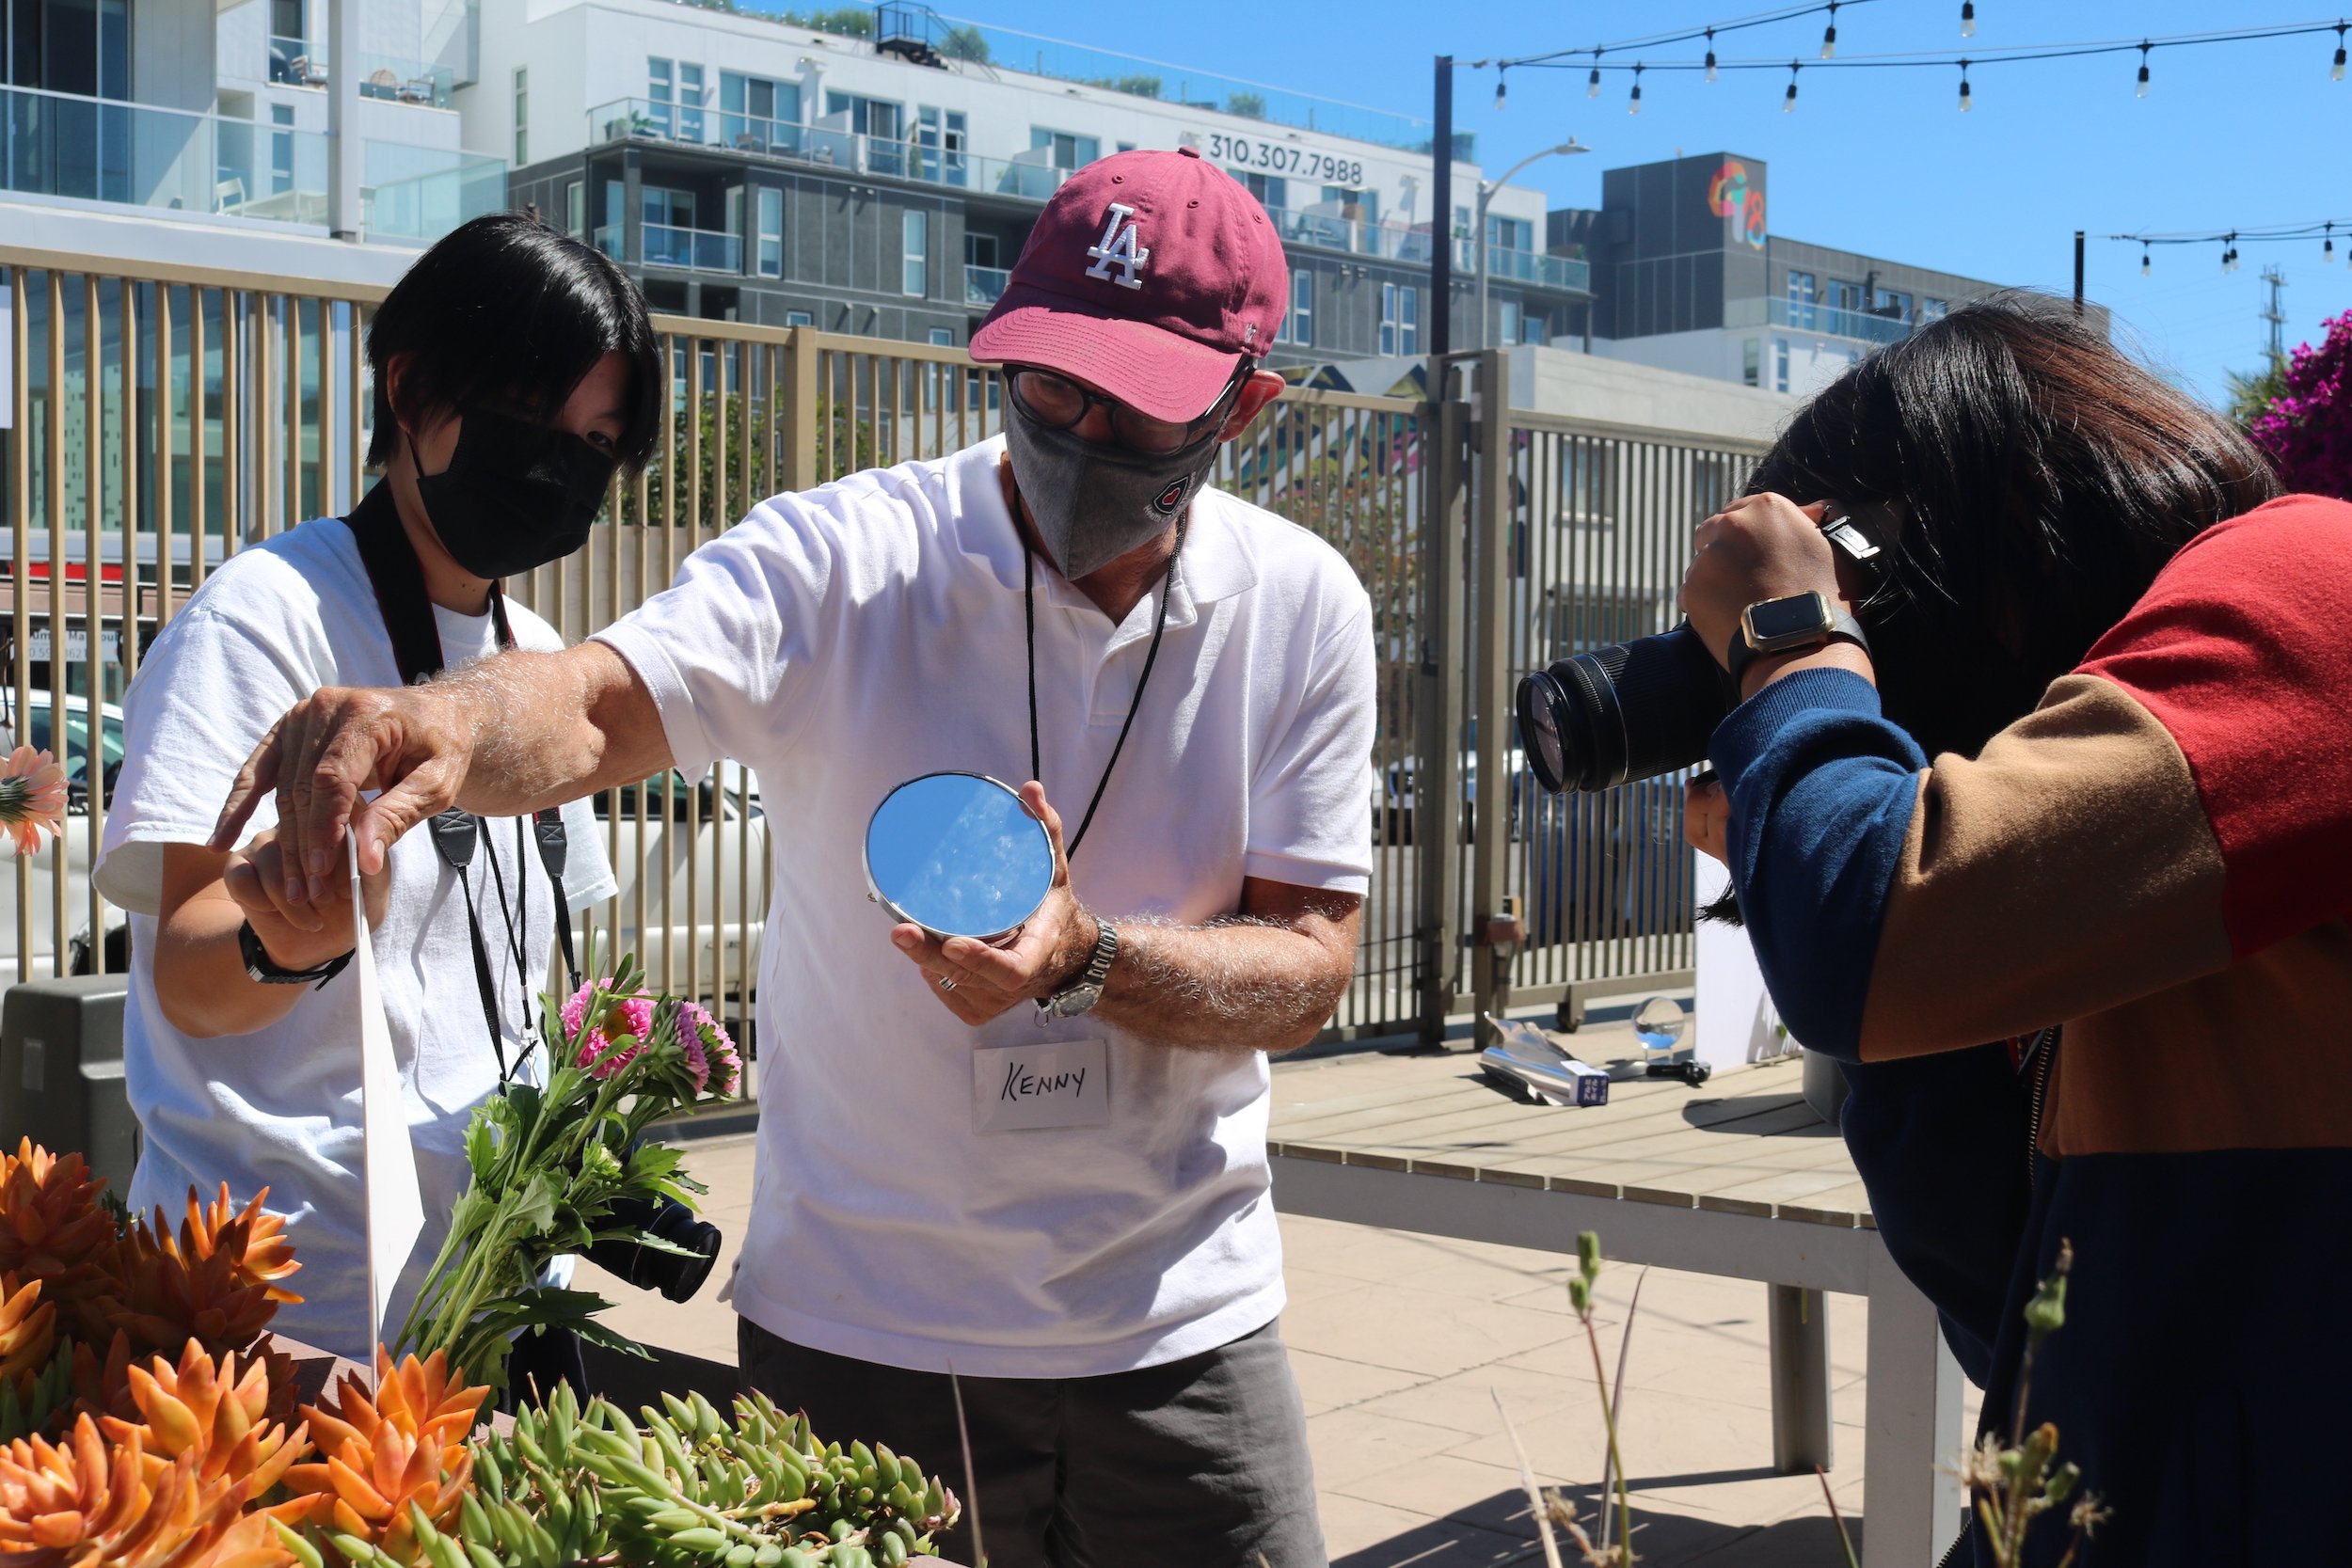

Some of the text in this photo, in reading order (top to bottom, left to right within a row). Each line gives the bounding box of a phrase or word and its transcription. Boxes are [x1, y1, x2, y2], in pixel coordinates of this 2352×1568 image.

[1210, 134, 1362, 185] 310.307.7988
[1085, 202, 1150, 291] LA
[1001, 1062, 1085, 1101] KENNY
